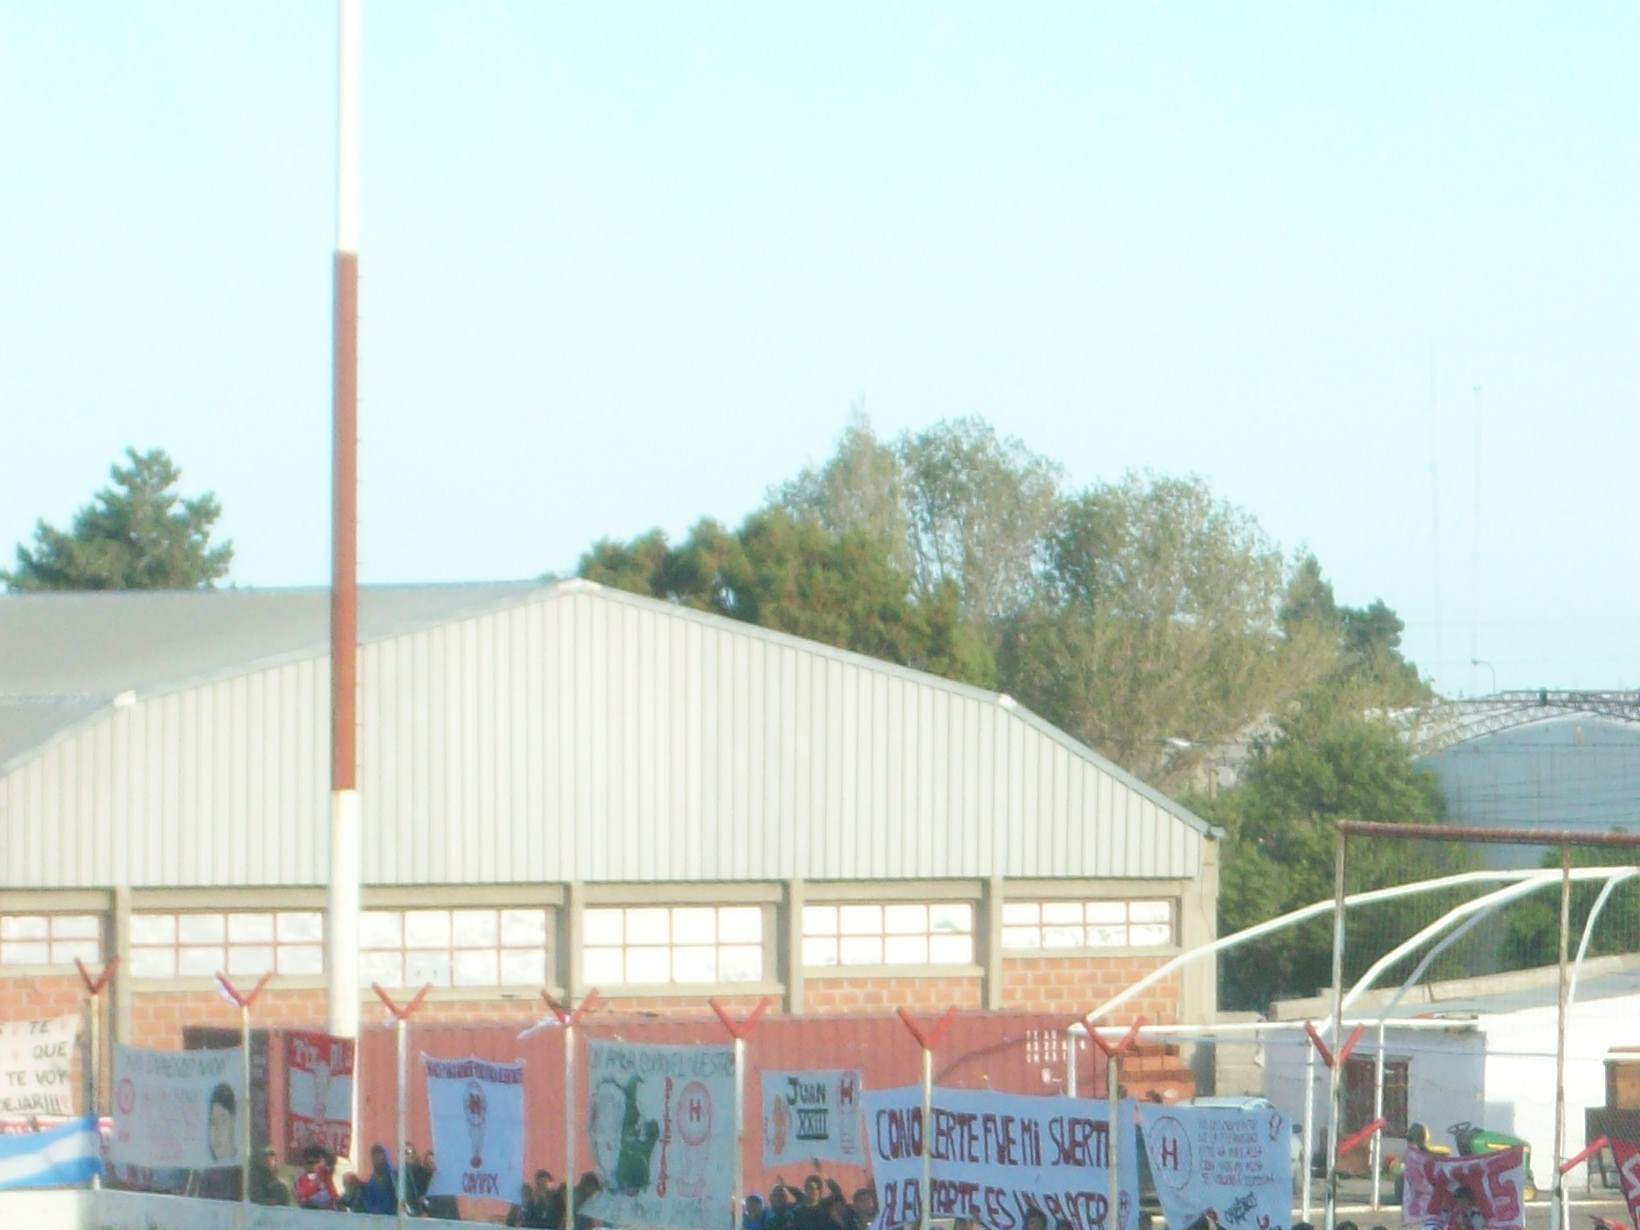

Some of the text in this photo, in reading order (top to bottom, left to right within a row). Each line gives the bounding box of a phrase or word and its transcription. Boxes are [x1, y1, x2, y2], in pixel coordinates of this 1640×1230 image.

[32, 1041, 67, 1060] QUE
[5, 1069, 67, 1087] TE VOY
[982, 1113, 1018, 1166] FUE
